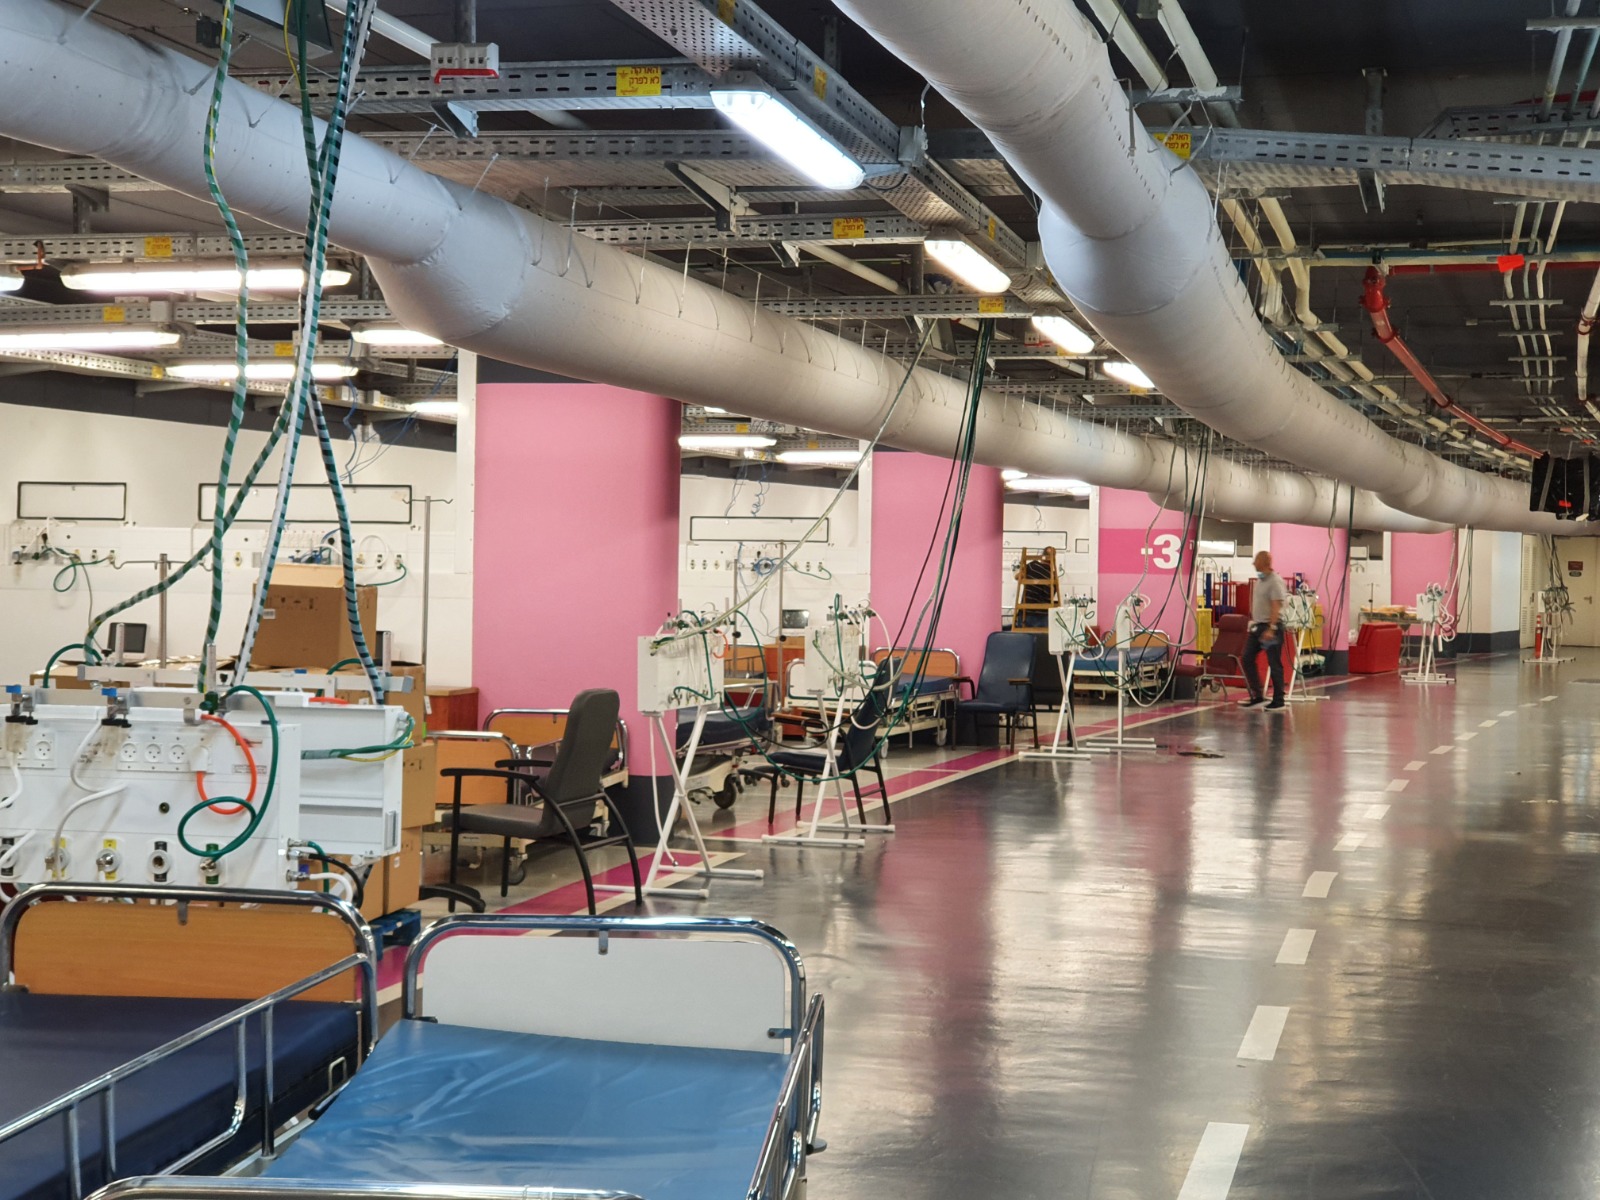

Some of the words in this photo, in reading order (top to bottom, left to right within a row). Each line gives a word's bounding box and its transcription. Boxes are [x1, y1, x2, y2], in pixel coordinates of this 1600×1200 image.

[629, 77, 648, 87] לפרק
[650, 76, 659, 84] לא
[1141, 534, 1182, 570] -3
